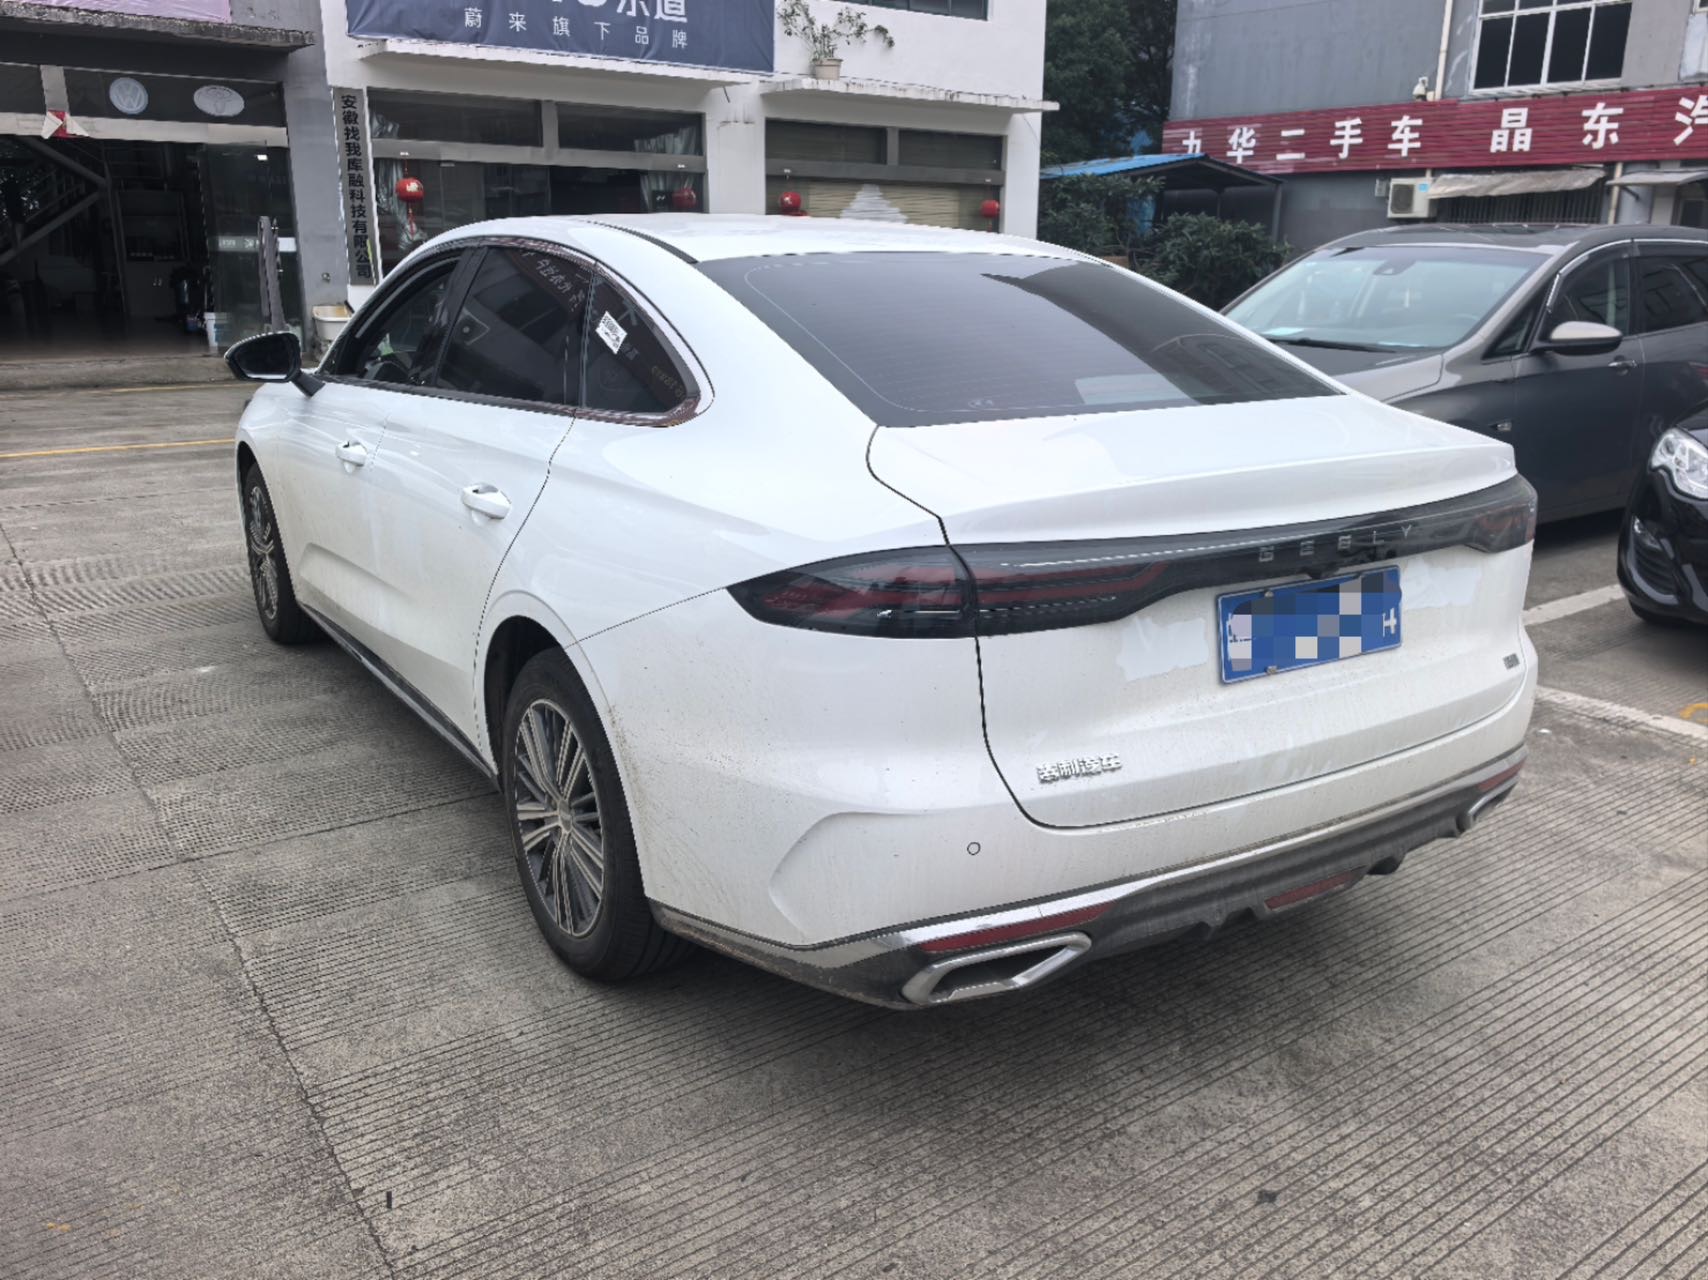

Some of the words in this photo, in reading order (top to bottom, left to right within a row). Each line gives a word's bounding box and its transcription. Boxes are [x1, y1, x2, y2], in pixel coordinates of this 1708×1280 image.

[464, 7, 688, 48] 蔚来旗下品牌
